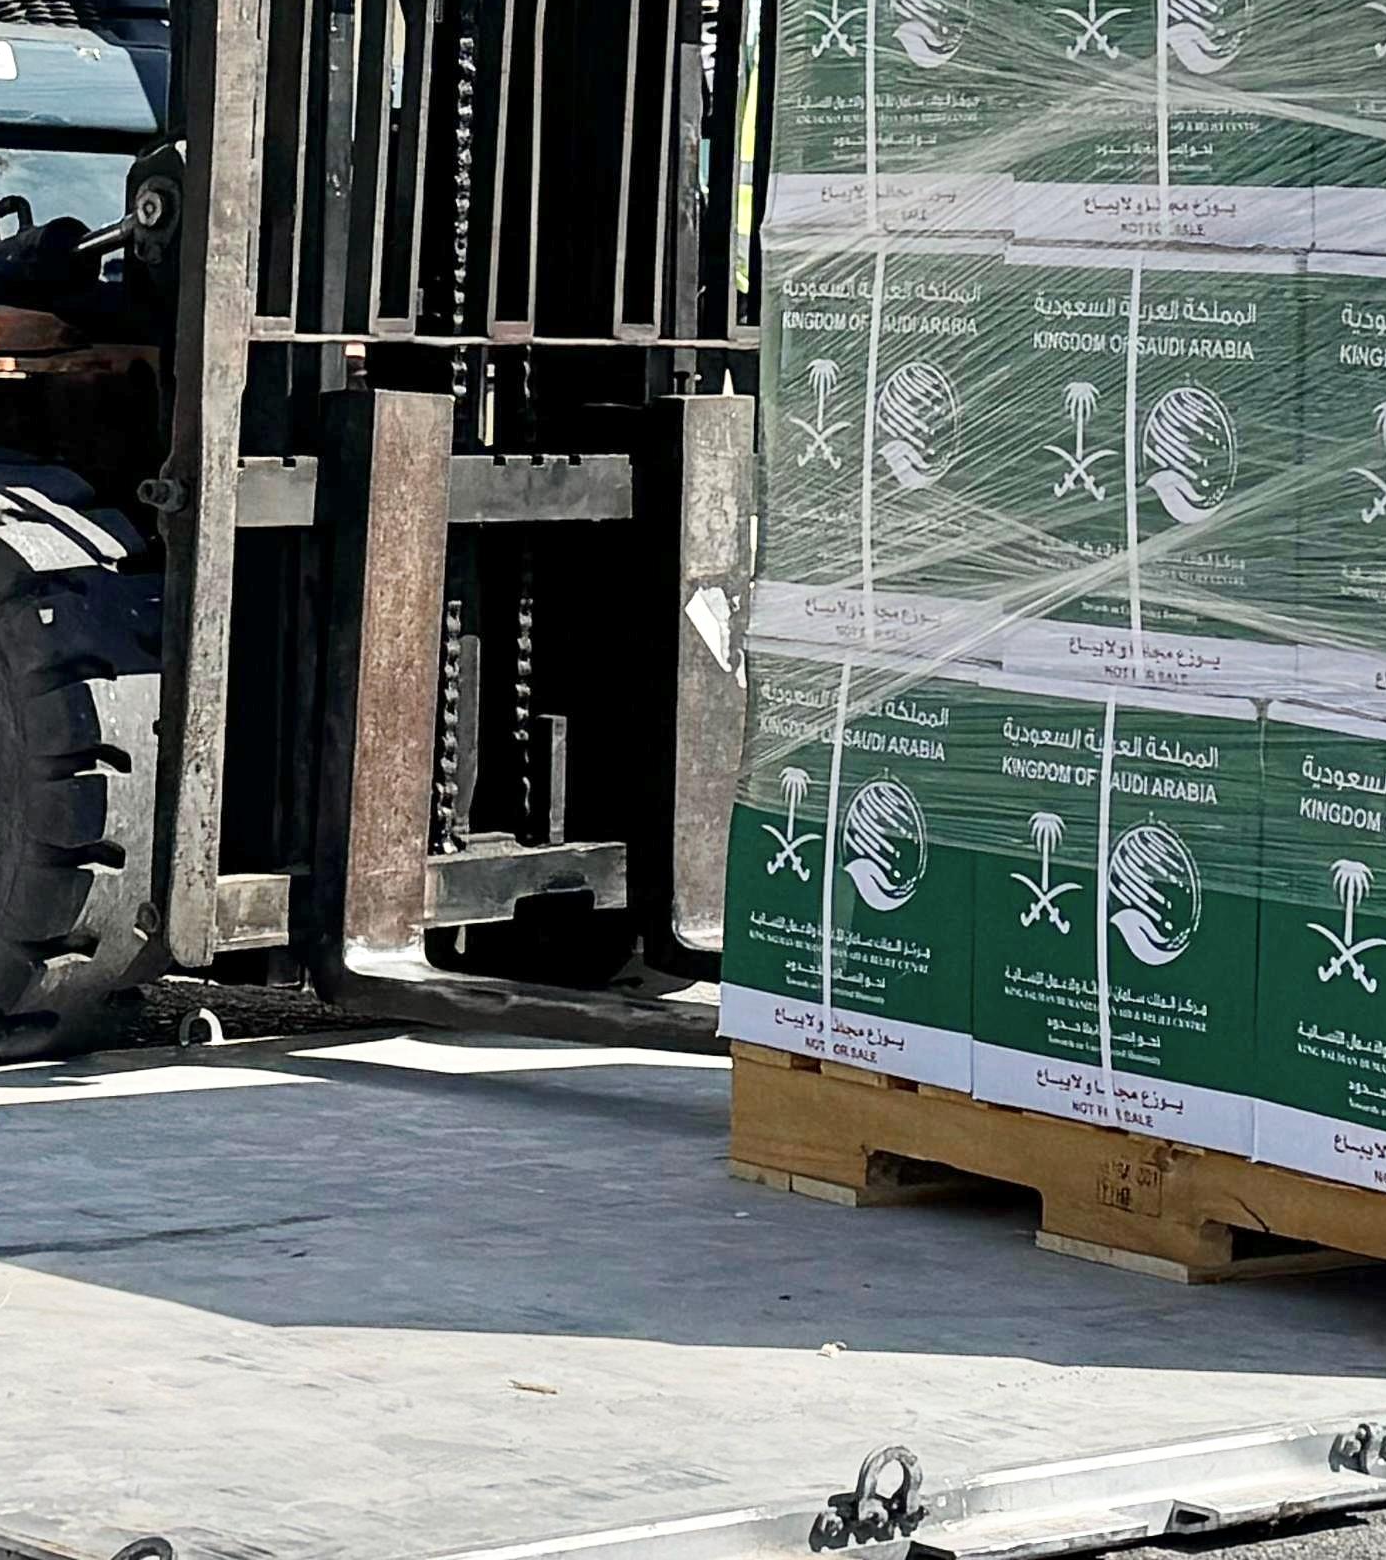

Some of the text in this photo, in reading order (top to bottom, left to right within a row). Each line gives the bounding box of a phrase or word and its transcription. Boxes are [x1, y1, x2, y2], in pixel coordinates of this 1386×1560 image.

[782, 310, 848, 332] KINGDOM
[873, 314, 916, 334] AUDI
[918, 317, 979, 336] ARABIA
[1033, 330, 1106, 353] KINGDOM
[1136, 335, 1188, 358] SAUDI
[1188, 340, 1255, 361] ARABIA
[885, 696, 950, 729] المملكة
[843, 728, 946, 761] SAUDI ARABIA
[1002, 716, 1219, 769] المملكة السعودية
[1001, 755, 1218, 805] KINGDOM OF AUDI ARABIA
[1299, 796, 1382, 833] KINGDOM
[850, 1045, 878, 1064] SALE
[1071, 1100, 1155, 1128] NOT SALE
